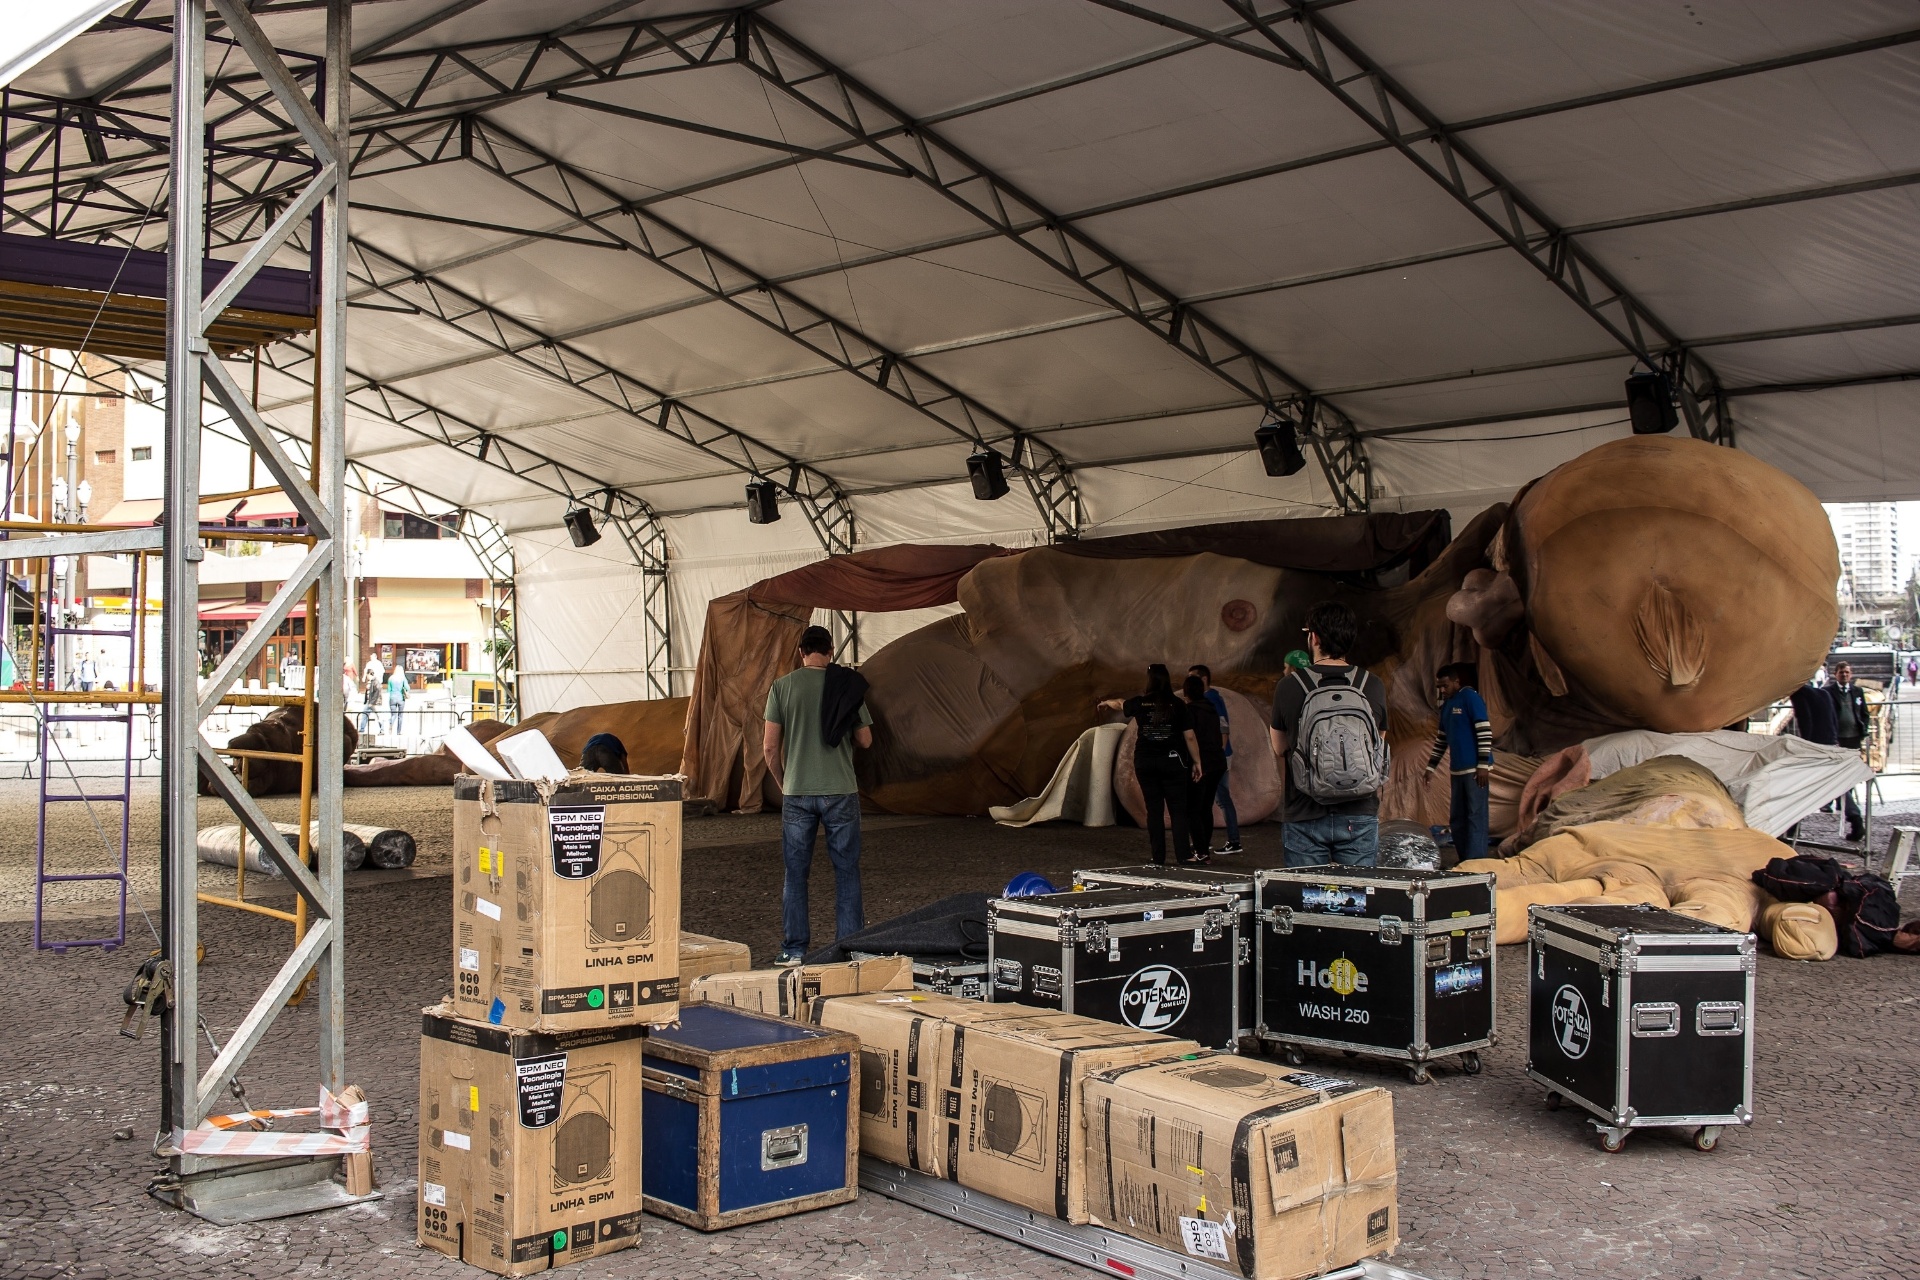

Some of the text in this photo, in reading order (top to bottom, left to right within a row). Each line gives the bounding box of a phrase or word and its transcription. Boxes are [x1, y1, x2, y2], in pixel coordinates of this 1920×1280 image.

[590, 785, 617, 793] CAIXA
[595, 792, 655, 801] PROFISSIONAL
[553, 814, 577, 822] SPM
[555, 824, 599, 833] Tecnologia
[554, 832, 601, 842] Neodímio
[585, 953, 654, 968] LINHA SPM
[548, 992, 588, 1001] SPM-1203A
[1123, 985, 1187, 1006] POTENZA
[1299, 1002, 1370, 1025] WASH 250
[1554, 1005, 1589, 1033] POTENZA
[555, 1031, 579, 1041] CAIXA
[559, 1034, 616, 1048] PROFISSIONAL
[519, 1061, 564, 1074] SPM NEO
[522, 1072, 562, 1083] Tecnologia
[520, 1080, 563, 1094] Neodímio
[910, 1085, 918, 1103] JBL
[526, 1104, 556, 1114] ergonomia
[531, 1099, 551, 1107] Melhor
[949, 1097, 957, 1114] JBL
[968, 1068, 979, 1153] SPM SERIES
[550, 1190, 614, 1213] LINHA SPM
[1371, 1215, 1384, 1230] JBL
[576, 1228, 592, 1242] JBL
[1190, 1220, 1205, 1253] GRU
[516, 1237, 549, 1250] SPM-1203
